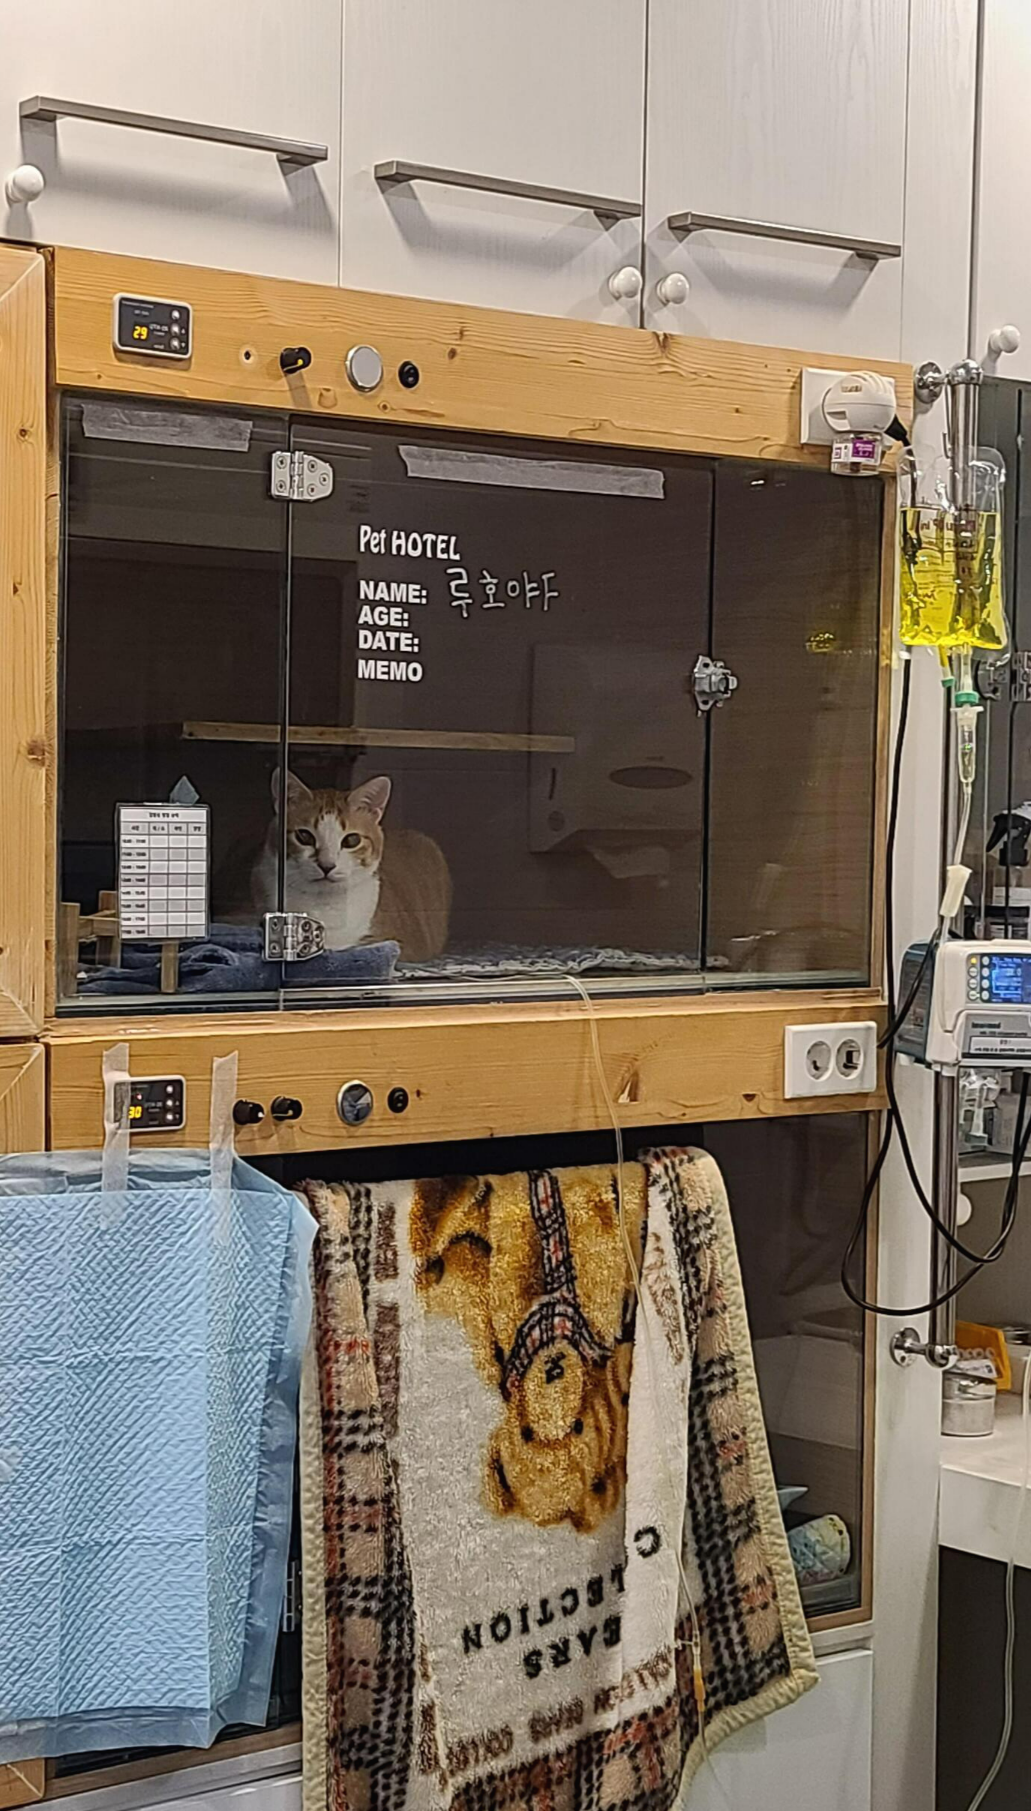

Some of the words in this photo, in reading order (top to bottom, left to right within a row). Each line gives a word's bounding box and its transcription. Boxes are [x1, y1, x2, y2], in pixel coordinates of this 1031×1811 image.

[132, 325, 148, 340] 29
[358, 524, 387, 555] Pet
[391, 530, 460, 560] HOTEL
[358, 579, 427, 604] NAME:
[357, 605, 409, 627] AGE:
[358, 629, 419, 653] DATE:
[357, 659, 423, 682] MEMO
[128, 1106, 142, 1119] 30
[523, 1615, 622, 1680] EARS
